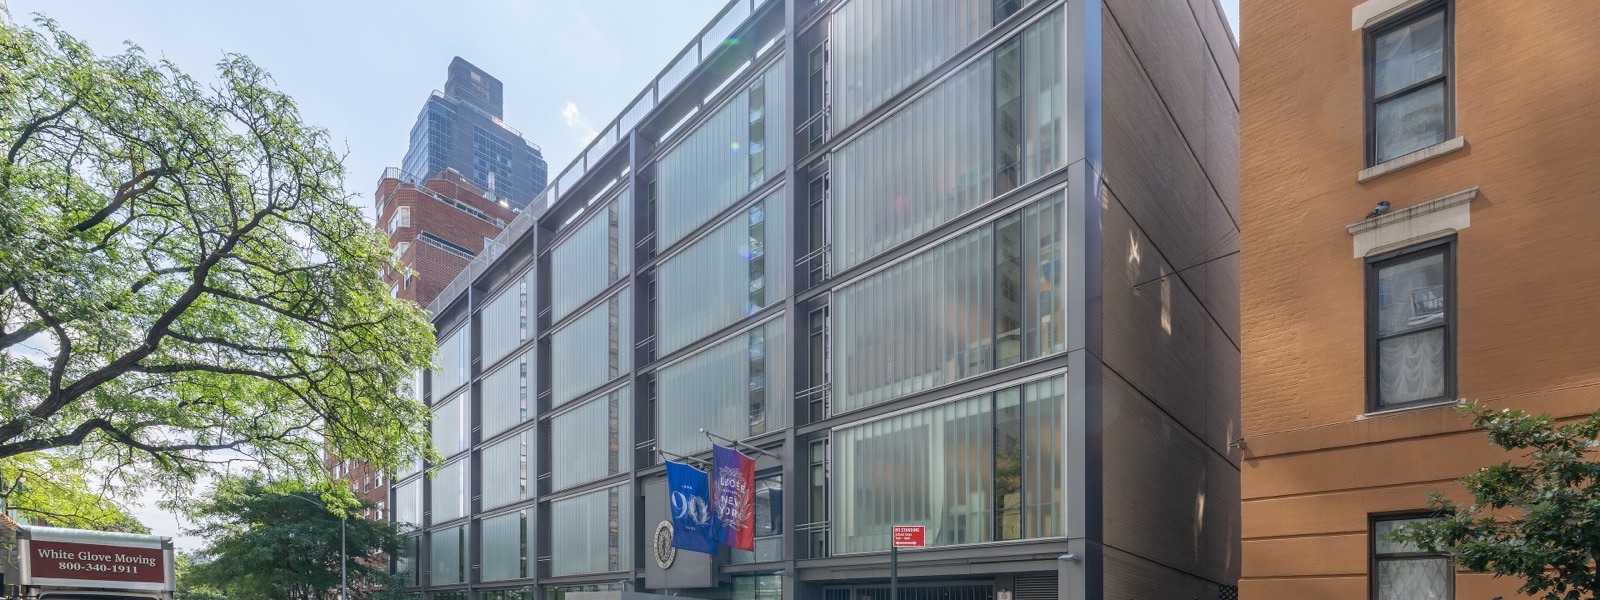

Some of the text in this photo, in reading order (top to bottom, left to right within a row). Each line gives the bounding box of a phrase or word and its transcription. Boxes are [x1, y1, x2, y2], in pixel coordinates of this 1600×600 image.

[671, 490, 709, 525] 90
[37, 548, 156, 567] White Glove Moving
[58, 562, 138, 574] 800-340-1911
